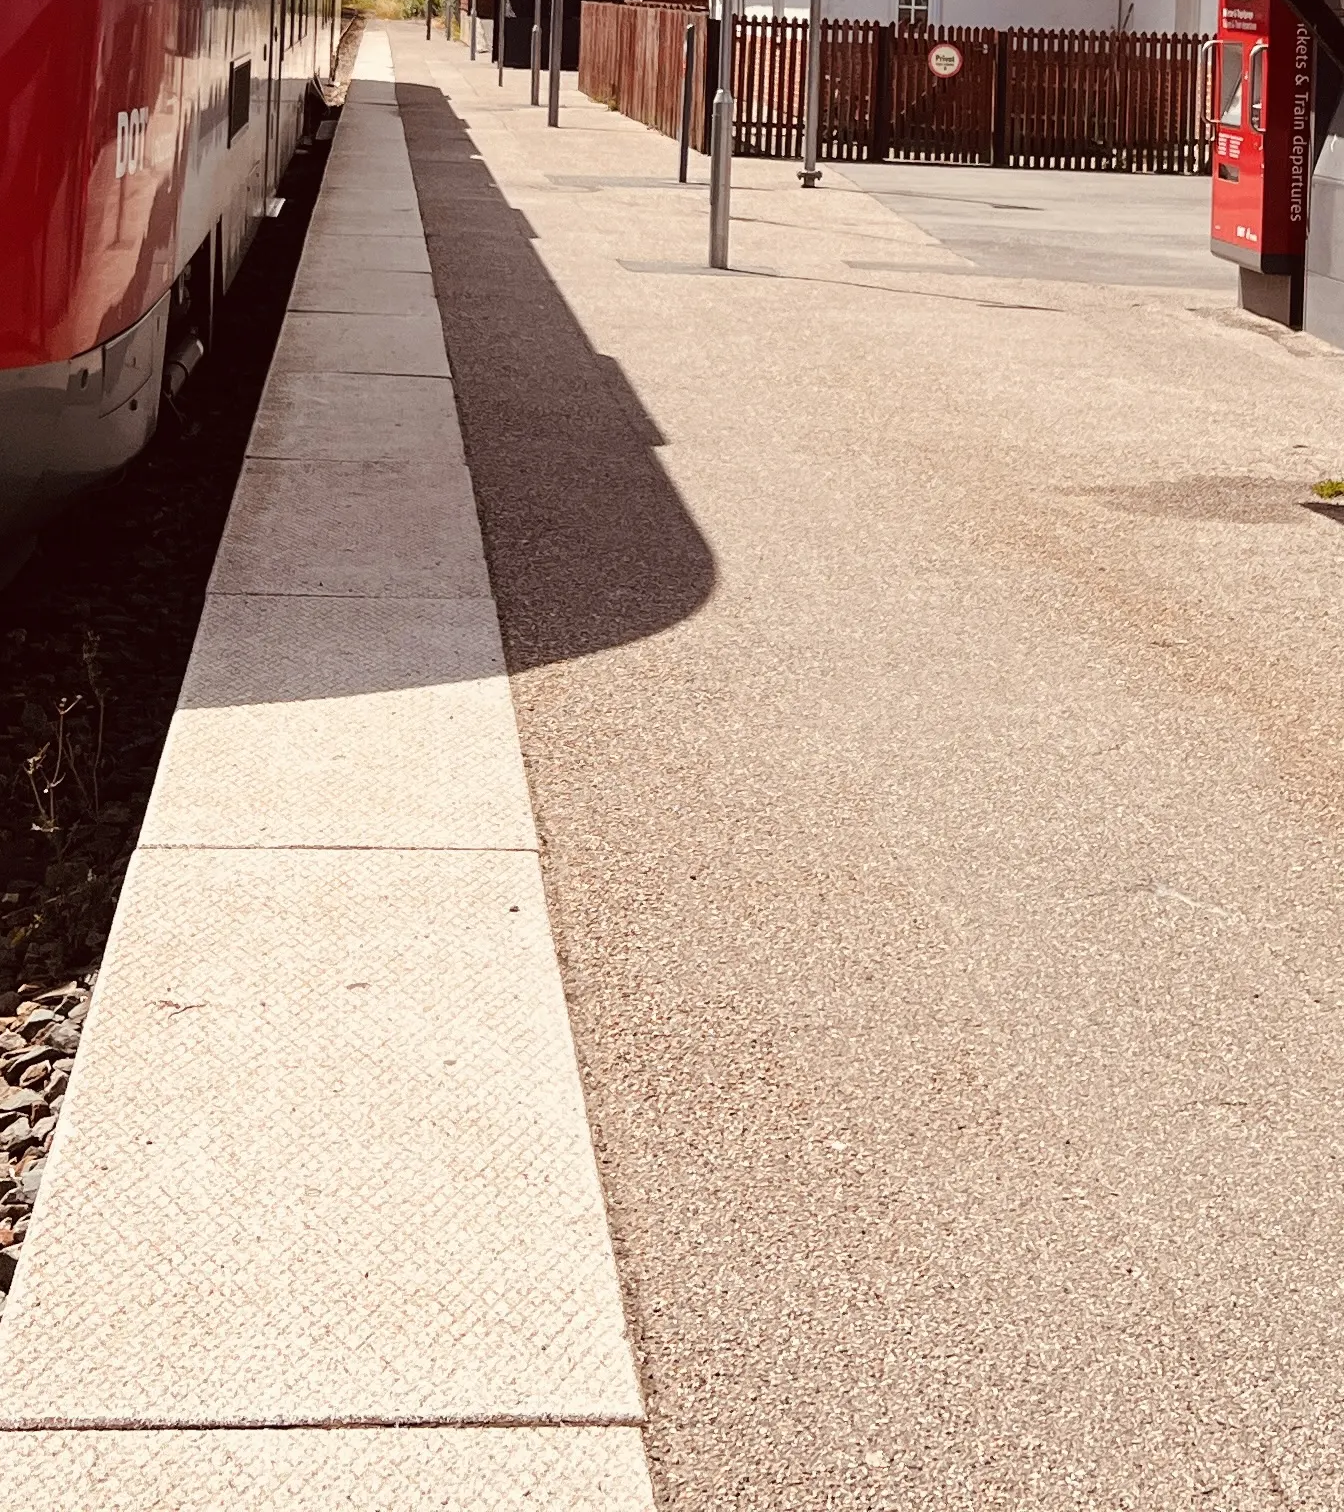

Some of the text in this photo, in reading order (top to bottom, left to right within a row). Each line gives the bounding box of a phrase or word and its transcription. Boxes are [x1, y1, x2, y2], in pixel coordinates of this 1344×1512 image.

[1295, 74, 1309, 86] &
[1293, 92, 1309, 130] Train
[1289, 135, 1307, 222] departures
